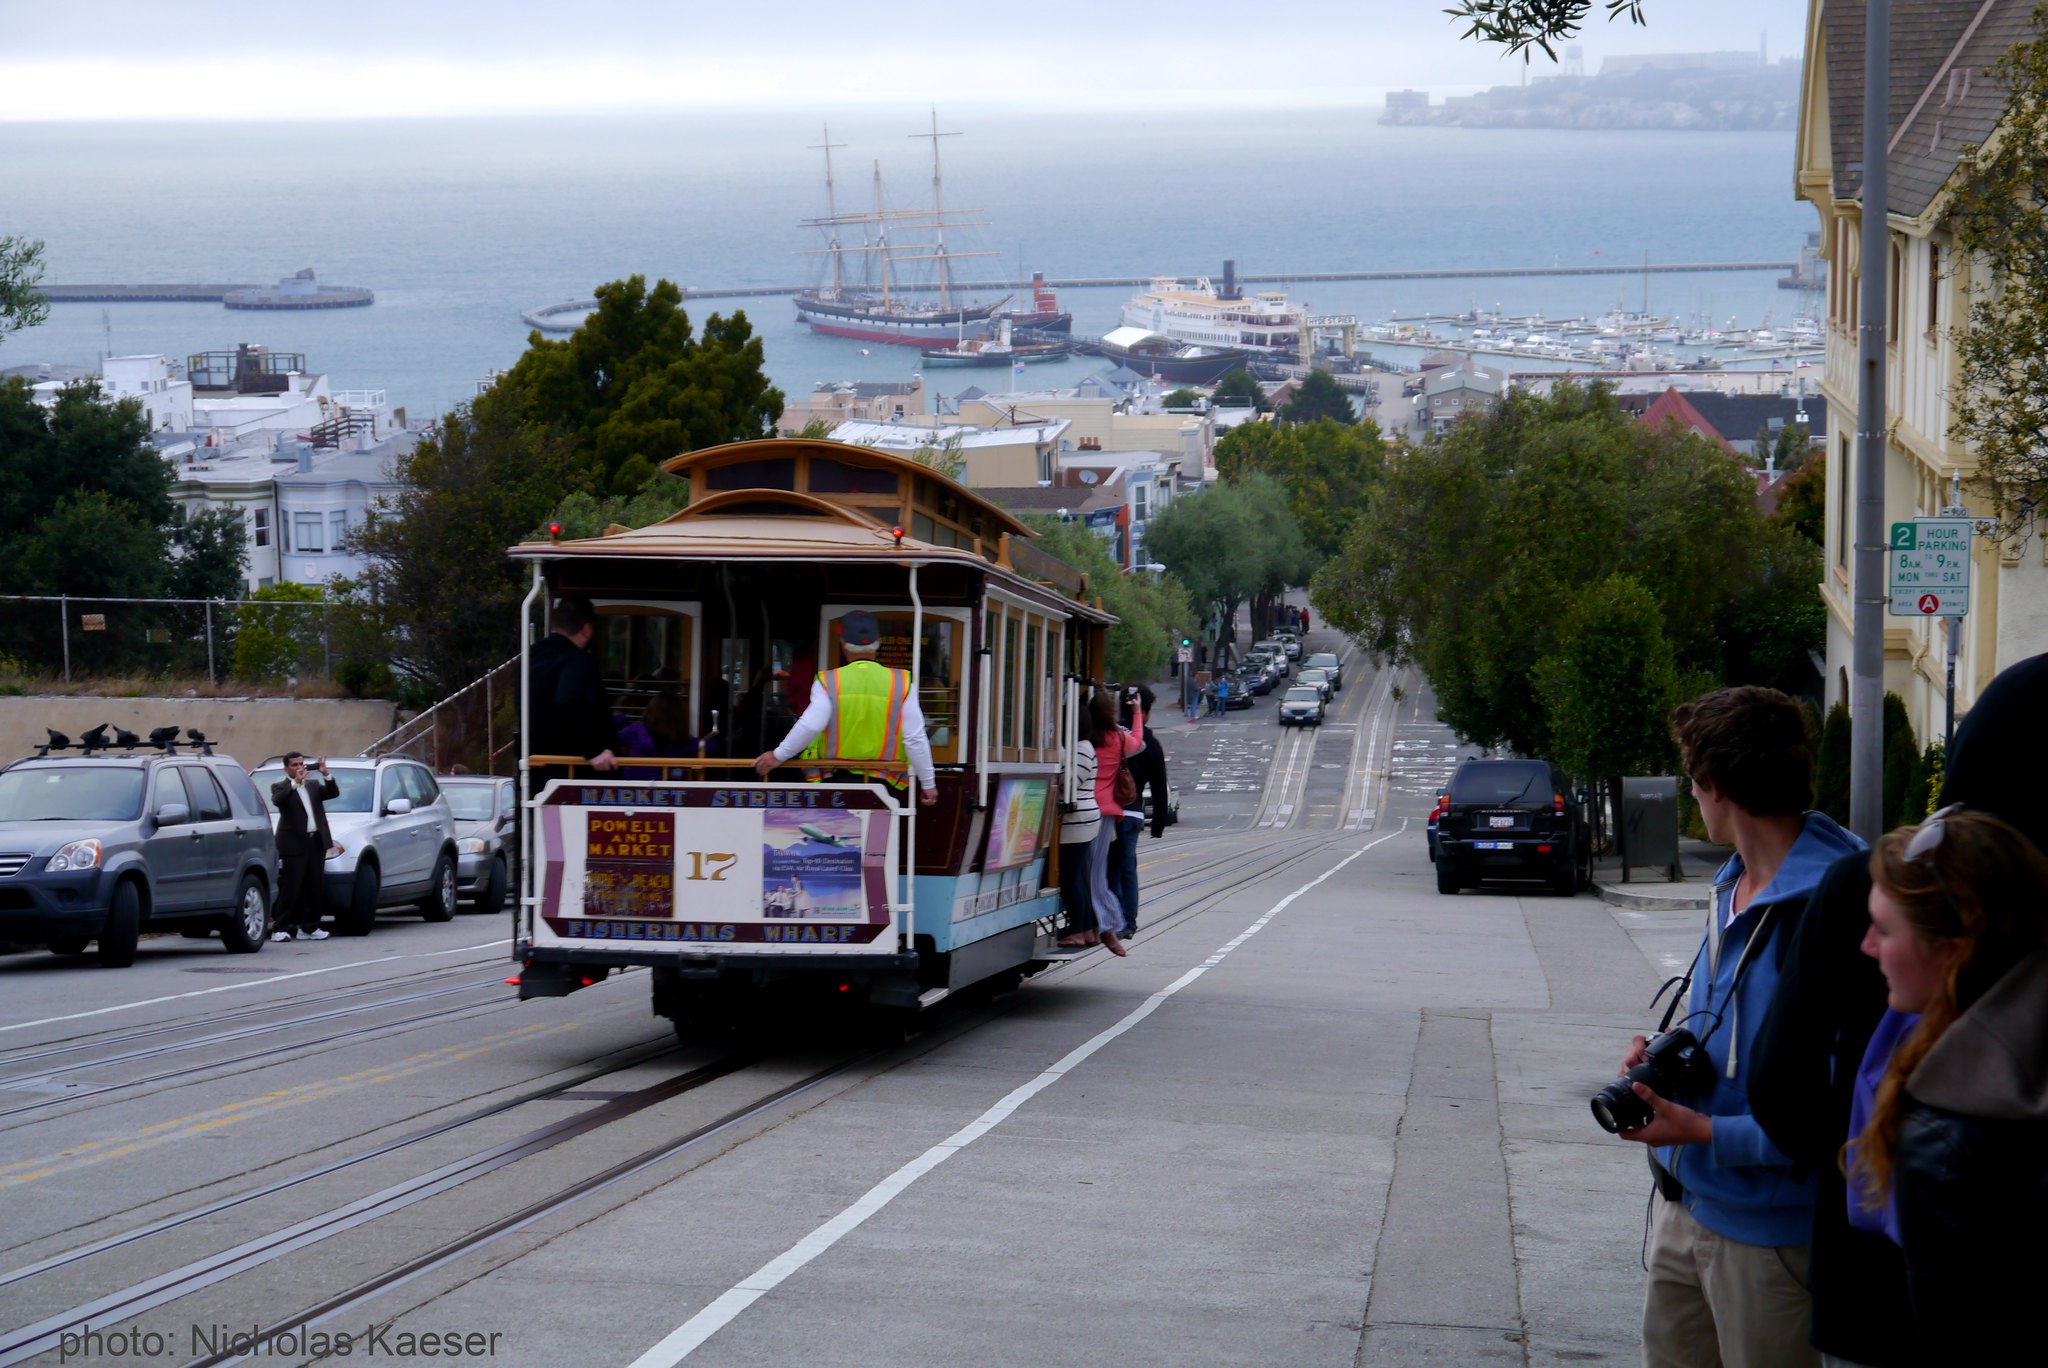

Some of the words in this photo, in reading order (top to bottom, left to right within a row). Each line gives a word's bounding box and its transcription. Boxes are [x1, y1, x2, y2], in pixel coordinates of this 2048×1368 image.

[1896, 527, 1911, 546] 2
[1927, 529, 1958, 539] HOUR
[1918, 541, 1967, 551] PARKING
[1898, 572, 1919, 582] MON
[1943, 572, 1961, 582] SAT
[1921, 596, 1936, 611] A
[580, 788, 688, 806] MARKET
[711, 790, 820, 807] STREET
[590, 819, 671, 833] POWELL
[610, 834, 651, 843] AND
[588, 844, 672, 857] MARKET
[686, 852, 738, 881] 17
[567, 921, 737, 941] FISHERMANS
[762, 925, 856, 943] WHARF
